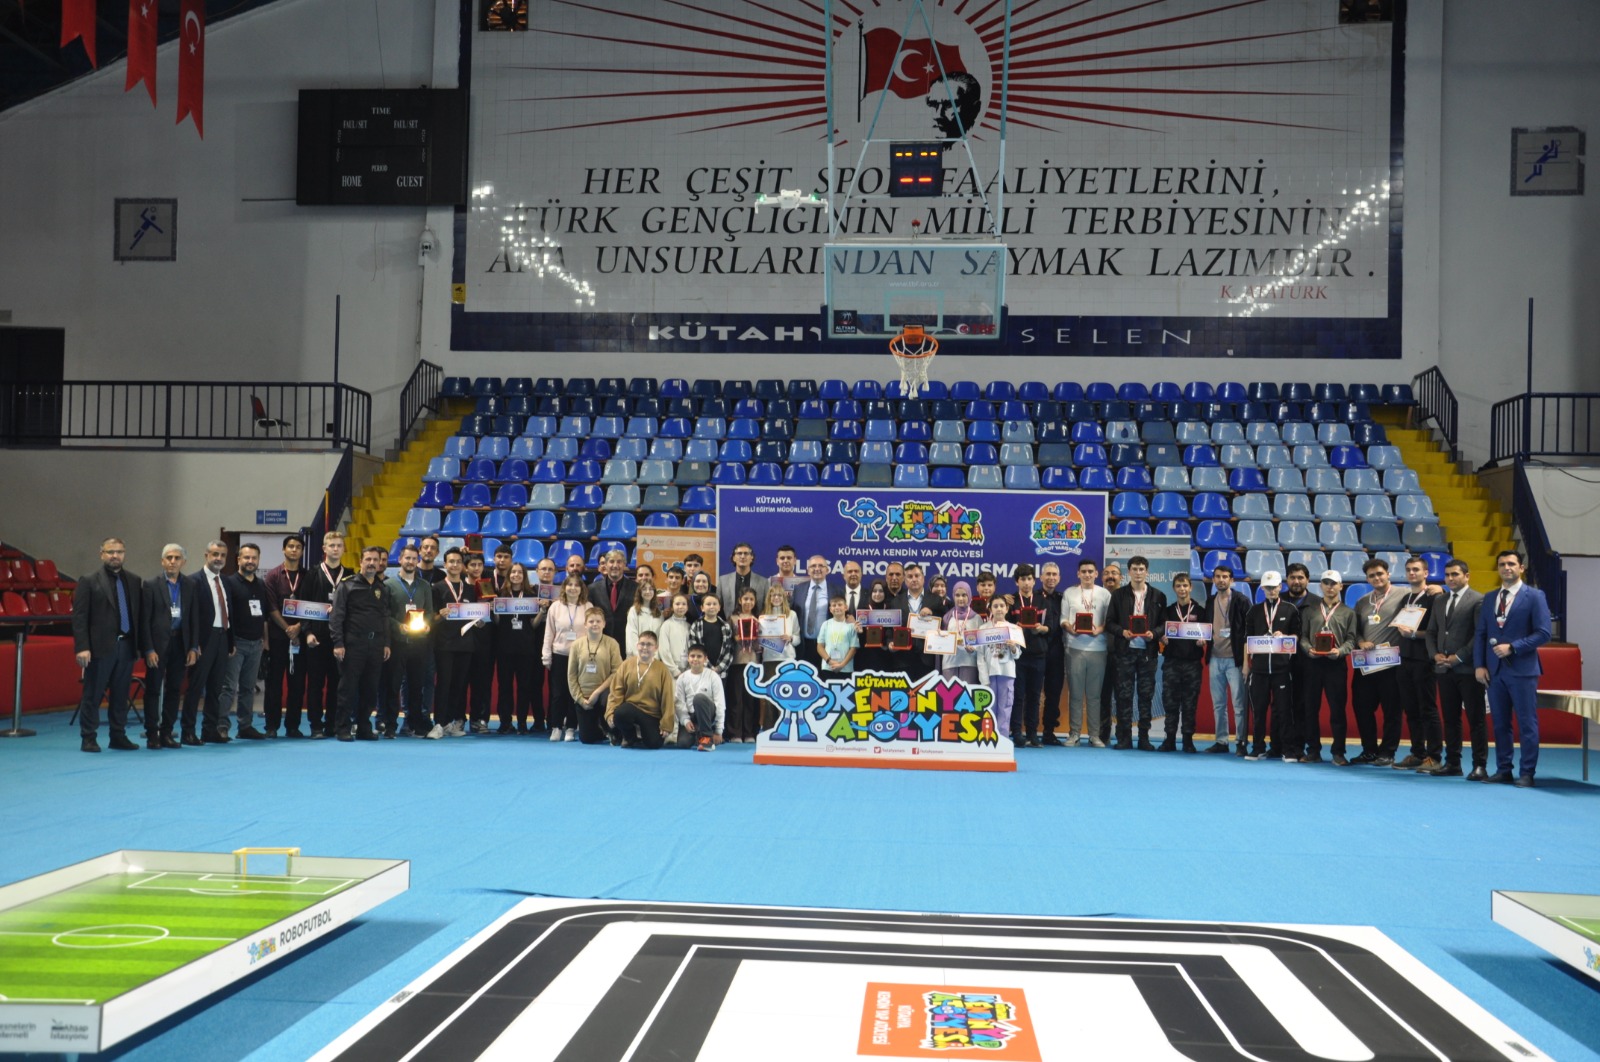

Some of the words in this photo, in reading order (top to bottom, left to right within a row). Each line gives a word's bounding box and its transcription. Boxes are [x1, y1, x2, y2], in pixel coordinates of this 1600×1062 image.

[371, 107, 391, 115] TIME
[371, 164, 388, 172] PERIOD
[341, 175, 363, 187] HOME
[396, 175, 424, 188] GUEST
[581, 167, 661, 195] HER
[686, 160, 793, 201] ÇEŞİT
[515, 199, 618, 234] TÜRK
[921, 199, 1040, 235] MİLLİ
[1062, 199, 1347, 235] TERBİYESİNİN
[596, 246, 935, 275] UNSURLARINDAN
[960, 247, 1126, 276] SAYMAK
[755, 496, 792, 505] KÜTAHYA
[734, 505, 740, 513] İL
[740, 505, 756, 513] MİLLİ
[756, 505, 776, 513] EĞİTİM
[776, 505, 813, 514] MÜDÜRLÜĞÜ
[904, 503, 934, 511] KÜTAHYA
[838, 546, 881, 556] KÜTAHYA
[882, 547, 918, 557] KENDİN
[920, 549, 939, 557] YAP
[940, 547, 984, 558] ATÖLYESİ
[304, 608, 321, 617] 6000
[1375, 655, 1391, 663] 8000
[856, 674, 908, 690] KÜTAHYA
[280, 909, 332, 947] ROBOFUTBOL
[875, 1009, 890, 1021] YAP
